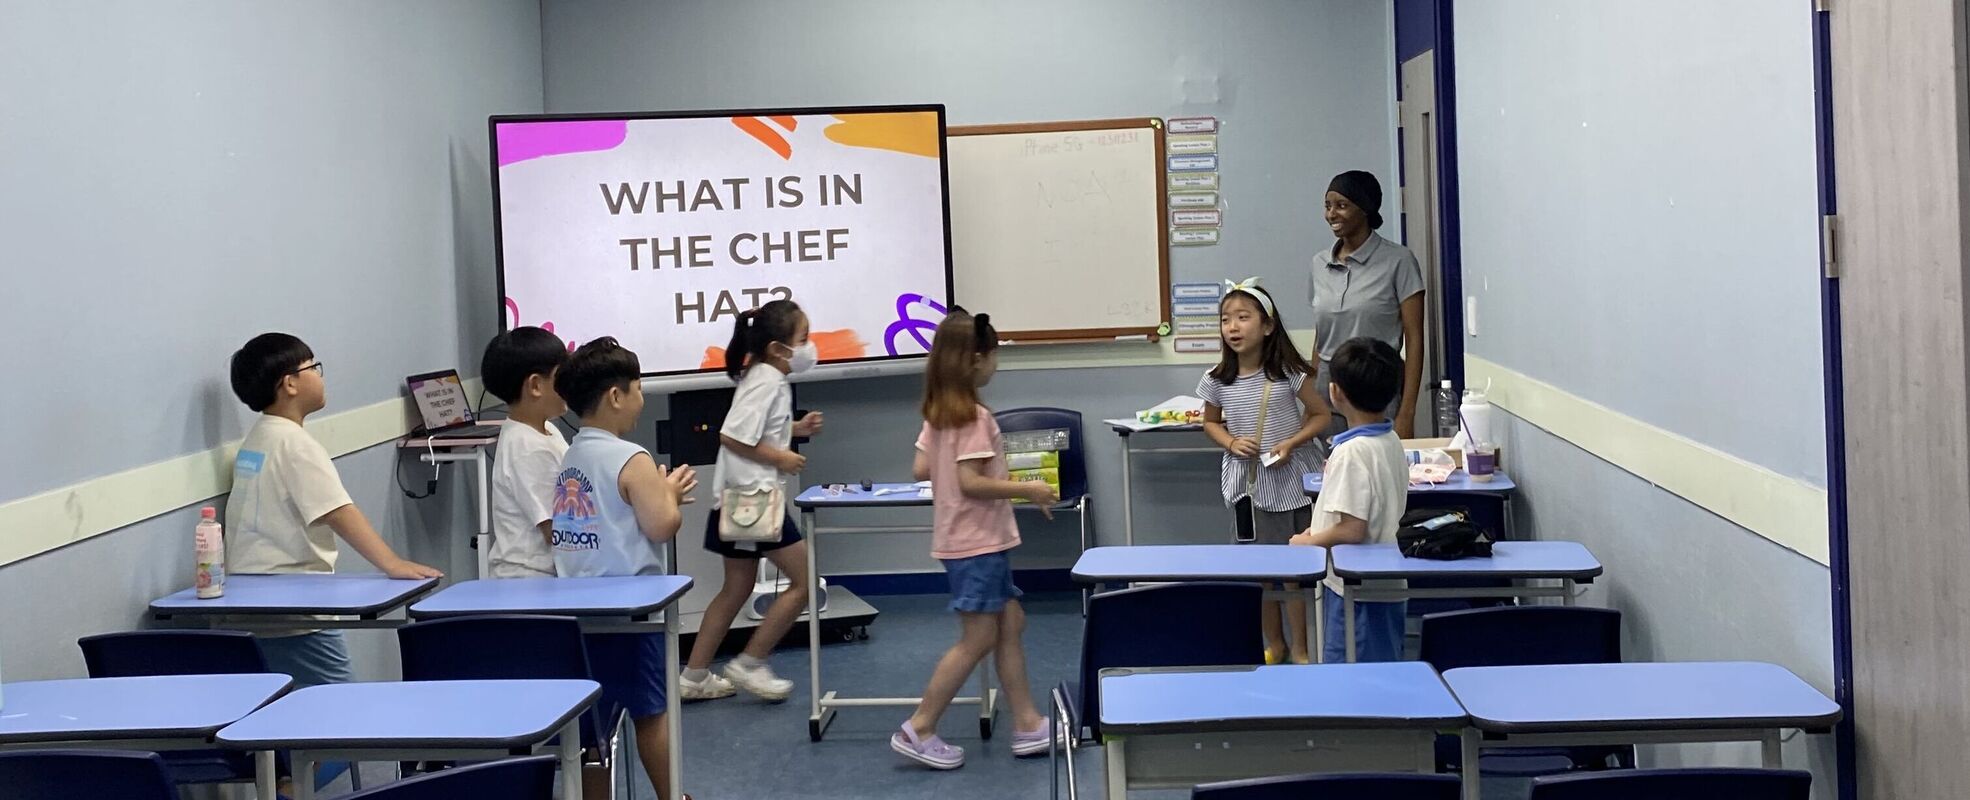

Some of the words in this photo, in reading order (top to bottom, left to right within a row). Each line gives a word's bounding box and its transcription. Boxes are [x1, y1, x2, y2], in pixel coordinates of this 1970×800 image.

[600, 177, 750, 215] WHAT
[765, 175, 804, 209] IS
[819, 173, 863, 206] IN
[619, 234, 715, 271] THE
[729, 228, 850, 265] CHEF
